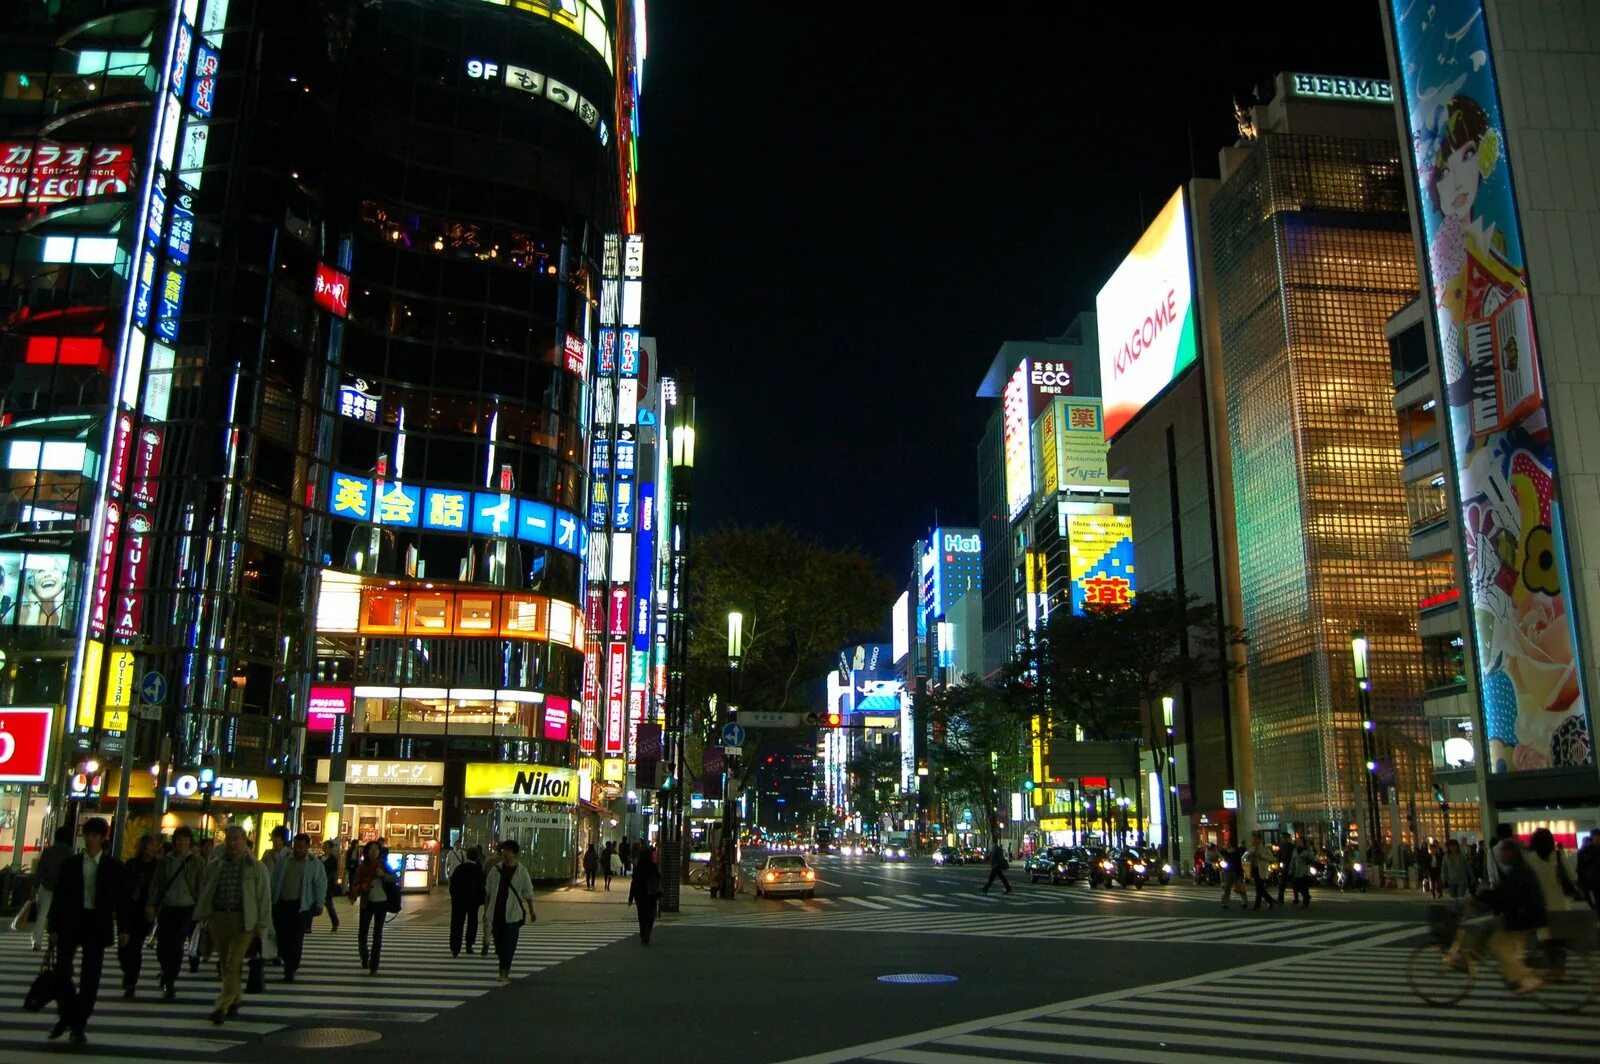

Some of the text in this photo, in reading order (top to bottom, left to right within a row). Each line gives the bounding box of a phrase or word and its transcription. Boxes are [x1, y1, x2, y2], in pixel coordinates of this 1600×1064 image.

[467, 60, 498, 80] 9F
[5, 146, 122, 166] カラオケ
[0, 166, 38, 174] Karaoe
[1114, 288, 1177, 381] KAGOME
[1031, 371, 1070, 386] ECC
[97, 523, 116, 621] FUJIYA
[166, 774, 259, 800] OTERIA
[512, 771, 570, 798] Nikon
[505, 815, 528, 823] Nikon
